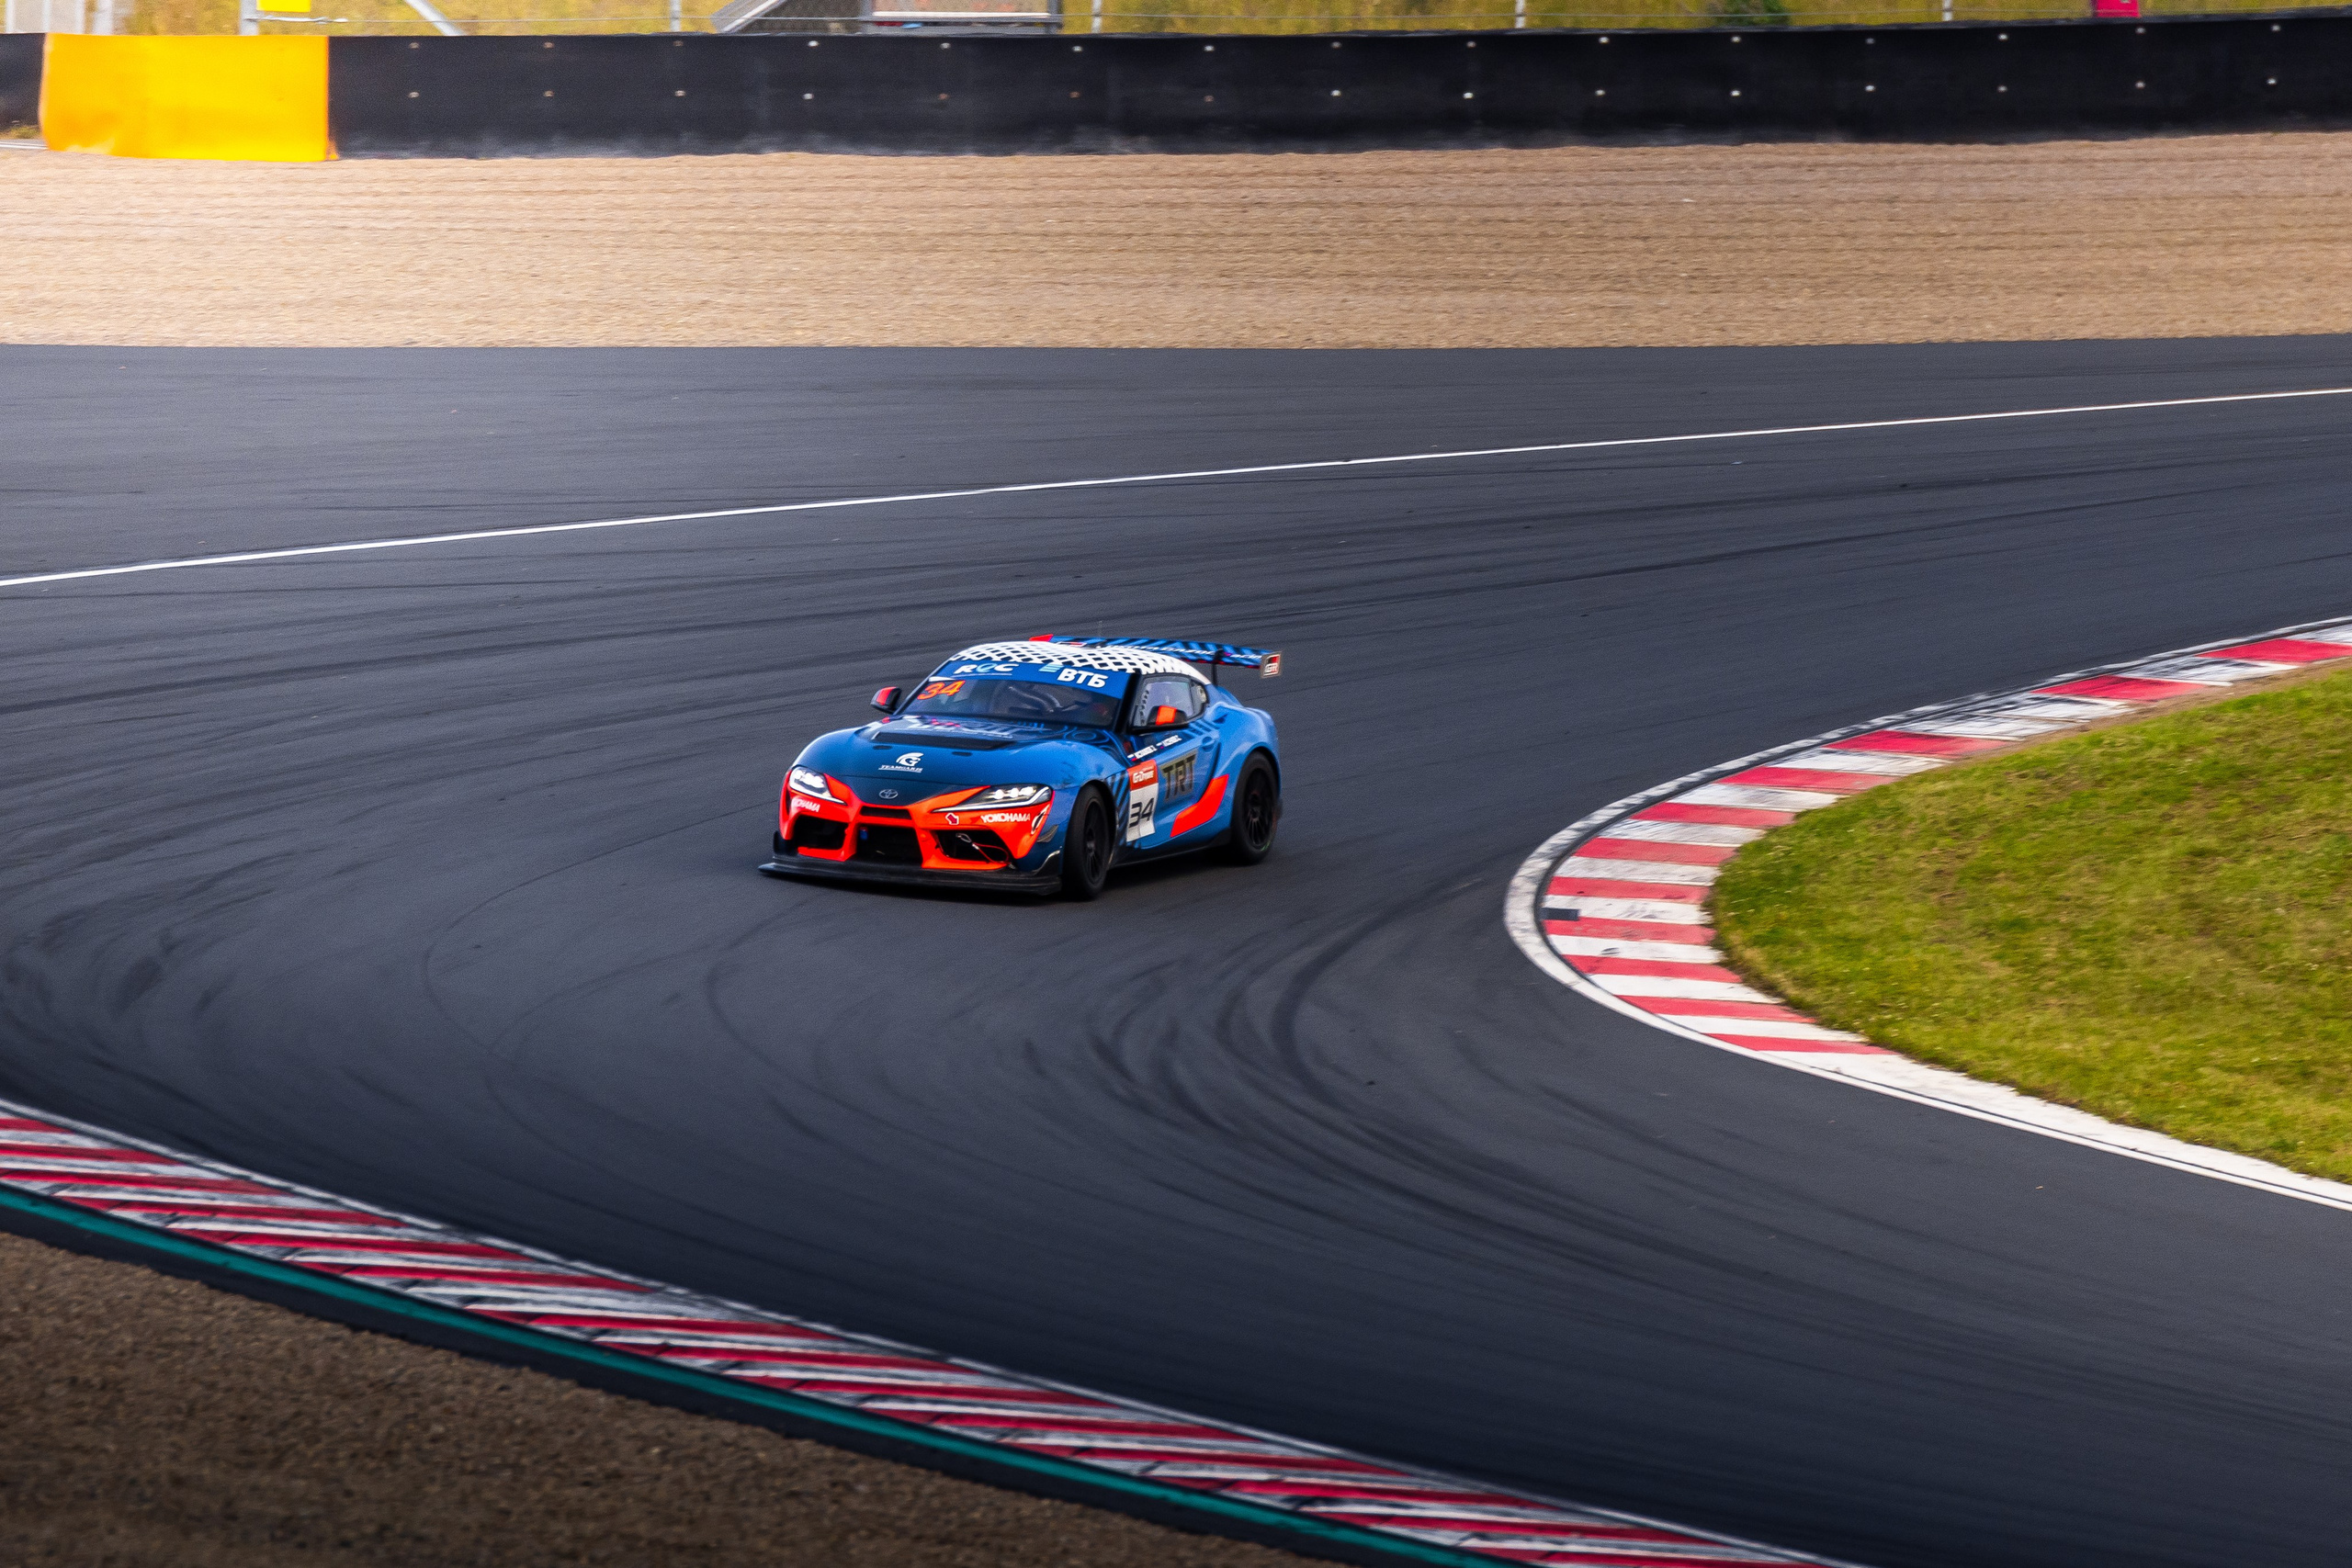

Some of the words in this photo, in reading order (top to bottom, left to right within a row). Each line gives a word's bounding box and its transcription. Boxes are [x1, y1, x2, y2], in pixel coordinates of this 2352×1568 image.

[1057, 668, 1109, 688] ВТБ
[917, 680, 967, 700] 34
[1161, 752, 1197, 800] TRT
[980, 812, 1031, 823] YOKOHAMA
[1128, 797, 1155, 829] 34
